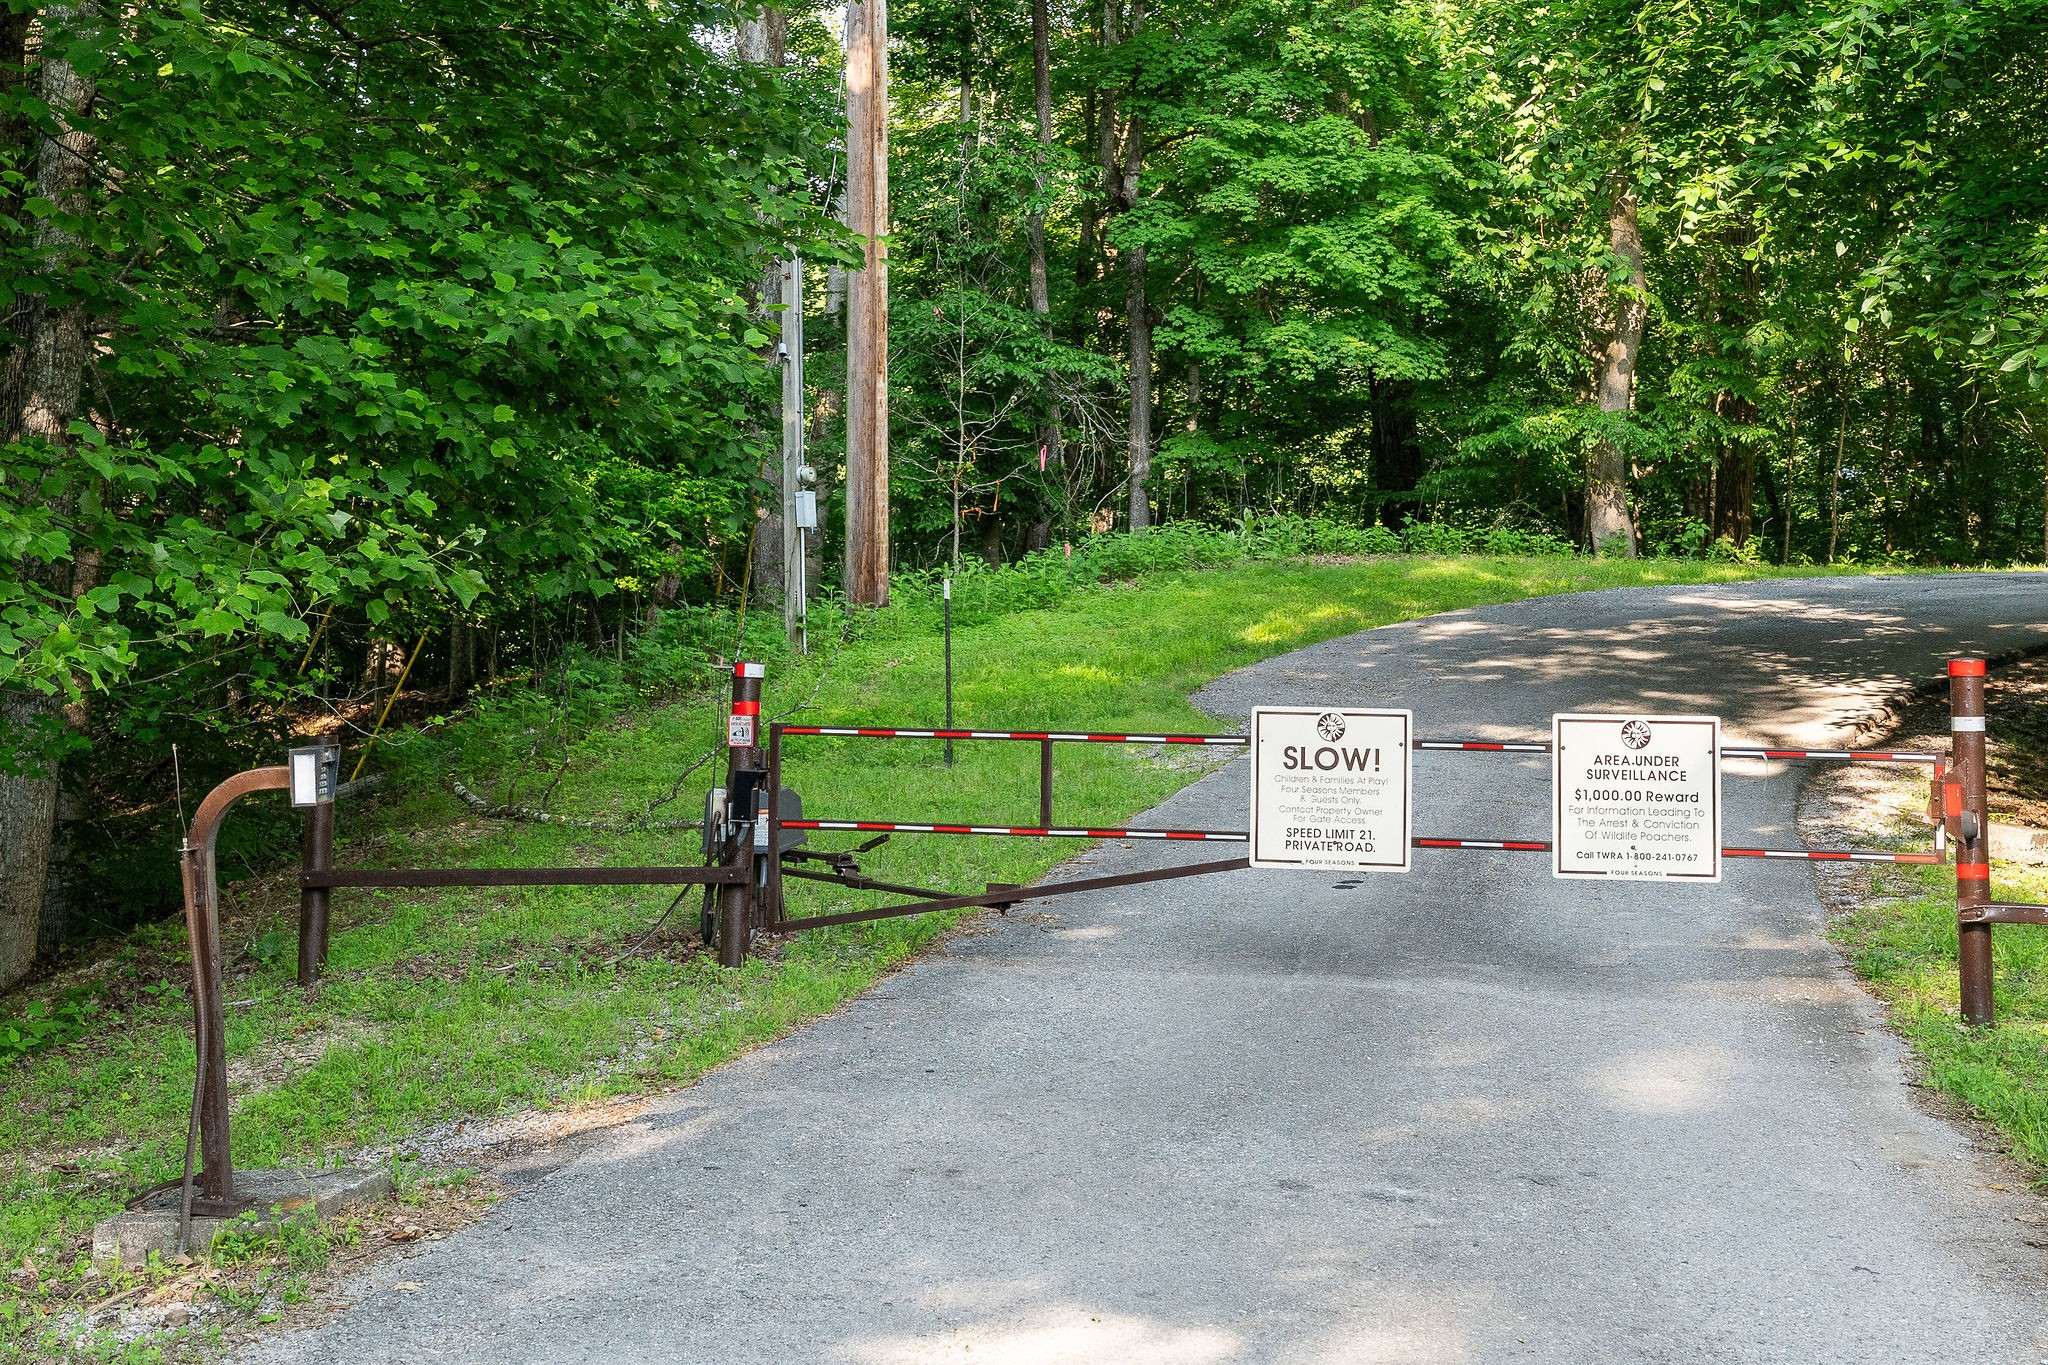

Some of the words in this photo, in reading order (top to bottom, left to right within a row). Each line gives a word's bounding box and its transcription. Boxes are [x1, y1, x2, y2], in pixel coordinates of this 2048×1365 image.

[1283, 746, 1380, 772] SLOW!
[1594, 755, 1633, 765] AREA
[1635, 756, 1680, 767] UNDER
[1274, 775, 1309, 783] Children
[1320, 776, 1354, 784] Families
[1369, 777, 1389, 786] Play!
[1587, 769, 1687, 781] SURVEILLANCE
[1281, 785, 1299, 793] Four
[1301, 786, 1337, 794] Seasons
[1339, 787, 1380, 796] Members
[1575, 789, 1642, 801] $1,000.00
[1646, 791, 1699, 803] Reward
[1311, 796, 1340, 804] Guests
[1279, 805, 1313, 813] Contact
[1316, 807, 1352, 816] Property
[1354, 807, 1383, 816] Owner
[1569, 805, 1584, 814] For
[1587, 806, 1645, 815] Information
[1648, 807, 1691, 819] Leading
[1694, 808, 1705, 817] To
[1577, 818, 1595, 827] The
[1599, 819, 1628, 828] Arrest
[1632, 819, 1639, 828] &
[1644, 819, 1699, 829] Conviction
[1286, 828, 1322, 838] SPEED
[1326, 829, 1355, 840] LIMIT
[1359, 830, 1376, 840] 21.
[1585, 831, 1598, 839] Of
[1600, 831, 1638, 840] Wildlife
[1641, 832, 1692, 842] Poachers.
[1285, 840, 1333, 851] PRIVATE
[1336, 841, 1376, 853] ROAD.
[1577, 851, 1594, 859] Call
[1597, 852, 1623, 860] TWRA
[1626, 853, 1698, 861] 1-800-241-0767
